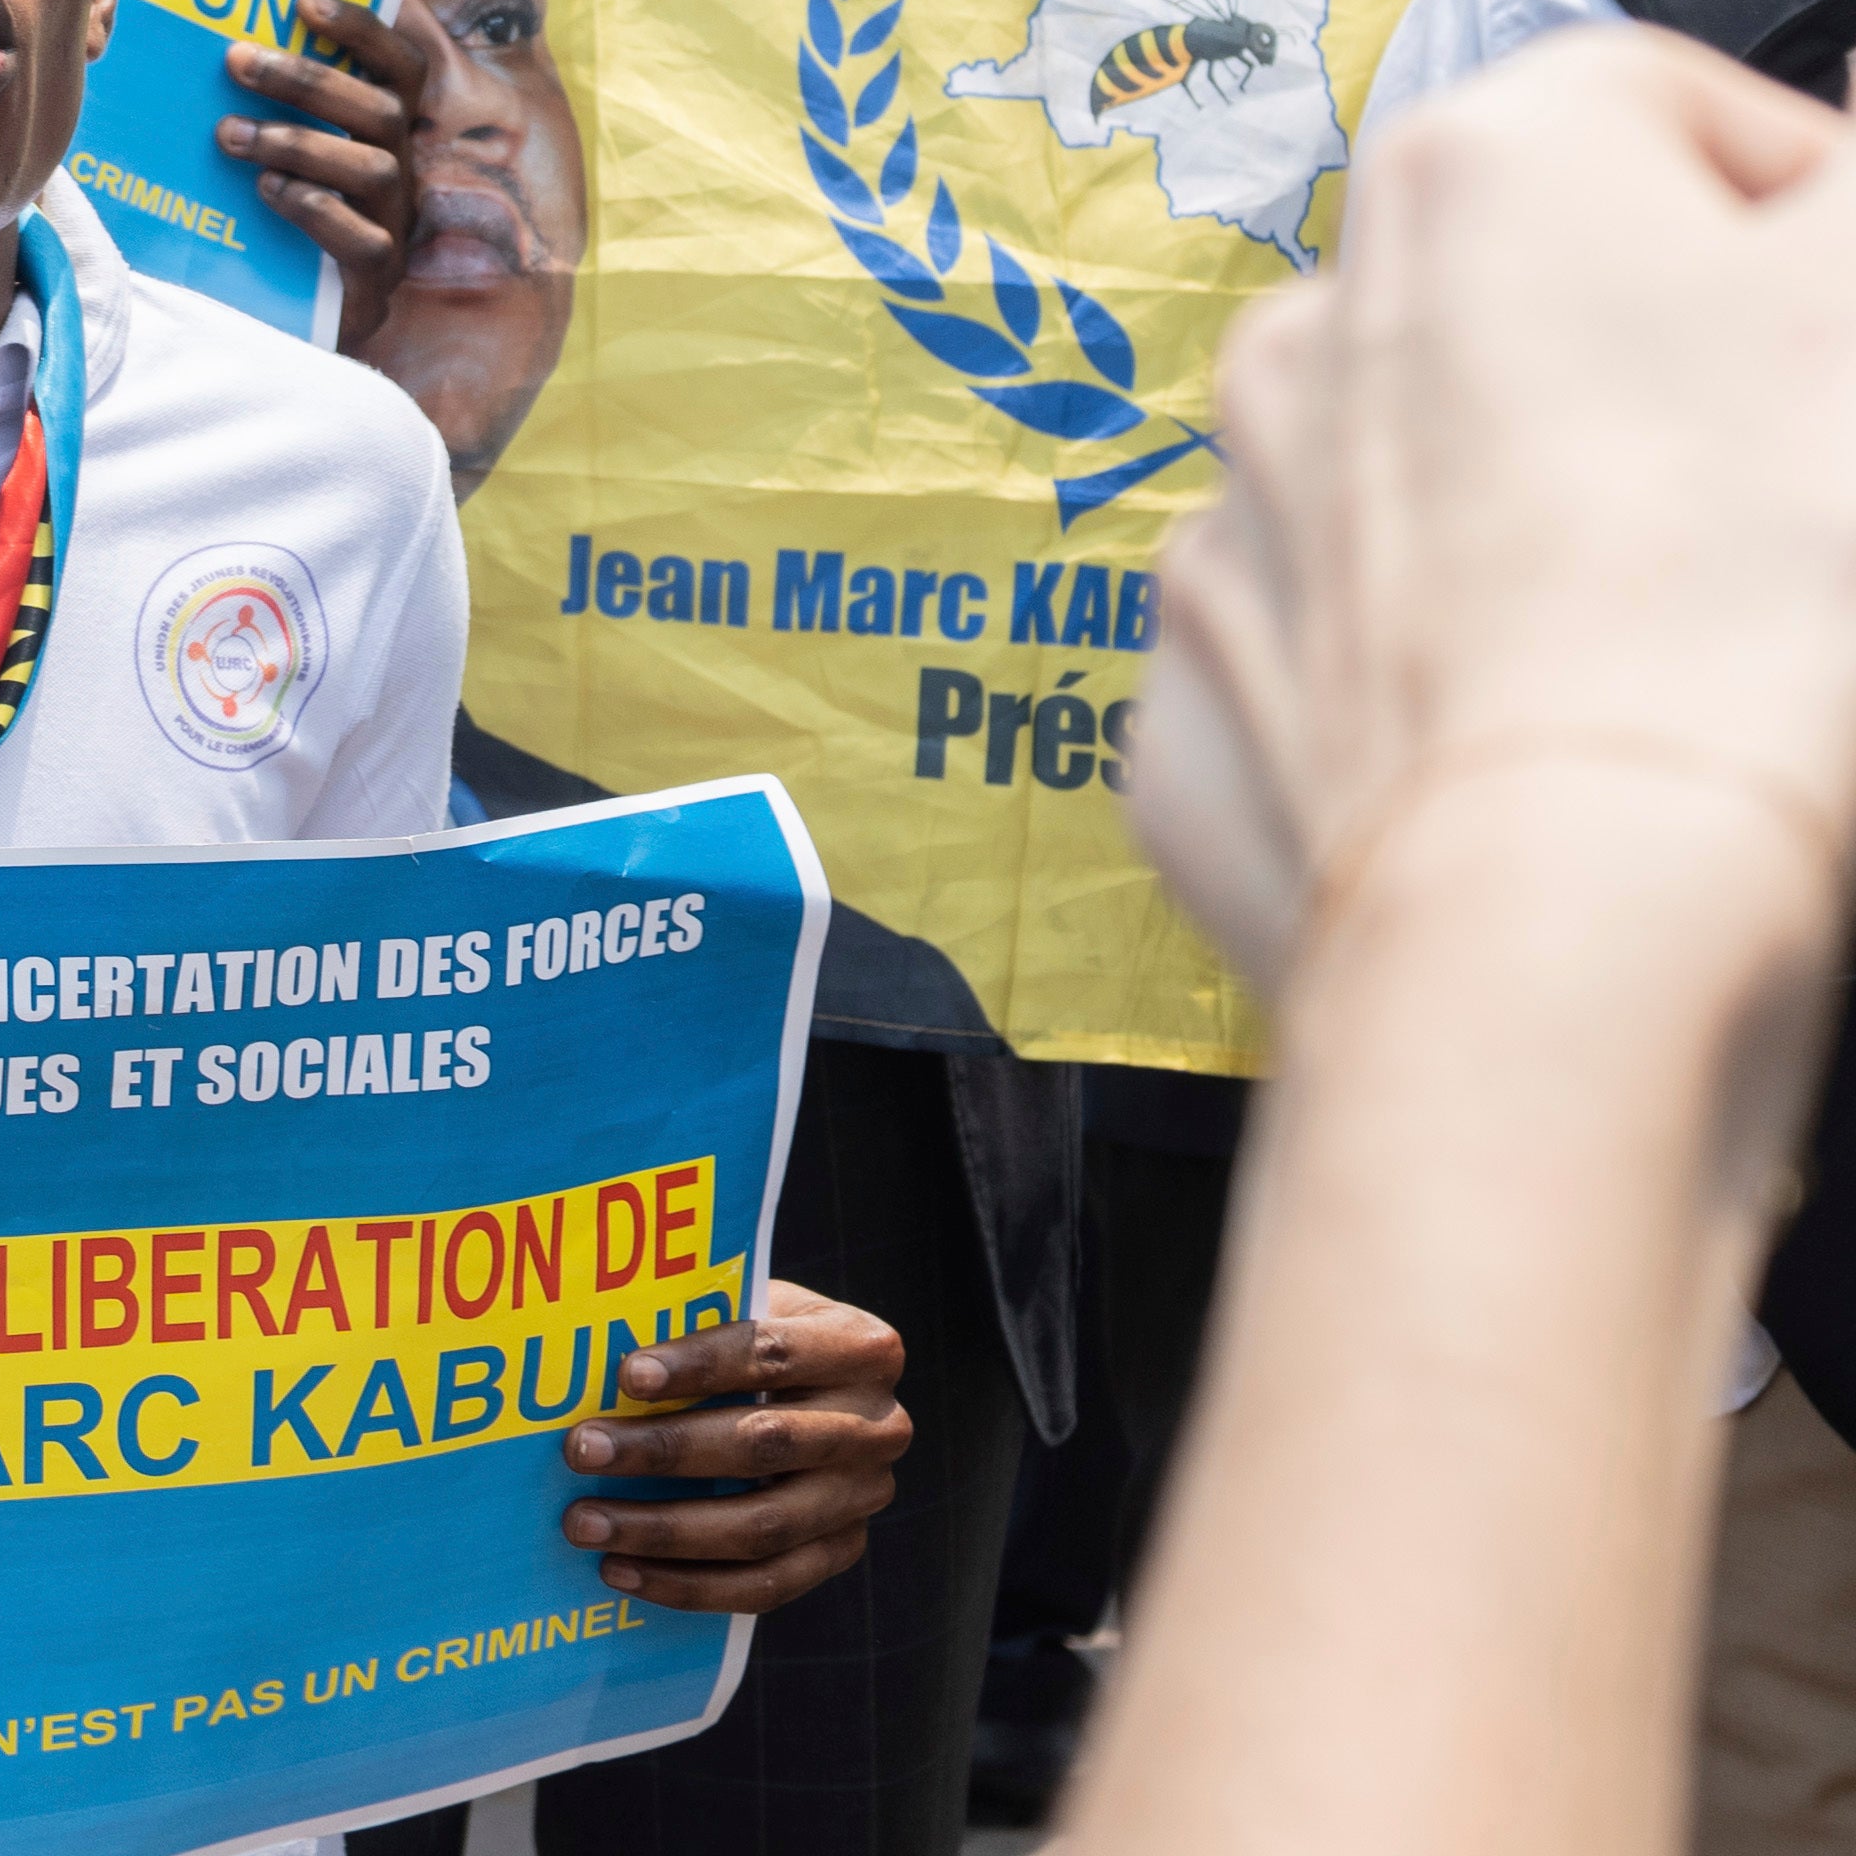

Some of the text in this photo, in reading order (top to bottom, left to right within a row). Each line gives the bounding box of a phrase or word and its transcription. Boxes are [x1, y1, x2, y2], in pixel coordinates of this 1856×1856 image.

[68, 152, 246, 251] CRIMINEL
[155, 620, 171, 672] UNION
[166, 591, 189, 618] DES
[190, 565, 246, 593] JEUNES
[560, 534, 1162, 654] Jean Marc KAB
[173, 714, 207, 747] POUR
[207, 735, 224, 752] LE
[376, 930, 493, 1000] DES
[504, 892, 707, 987] FORCES
[109, 1047, 184, 1109] ET
[195, 1024, 493, 1106] SOCIALES
[593, 1165, 701, 1294] DE
[171, 1679, 286, 1733] PAS
[302, 1657, 379, 1705] UN
[395, 1597, 647, 1684] CRIMINEL
